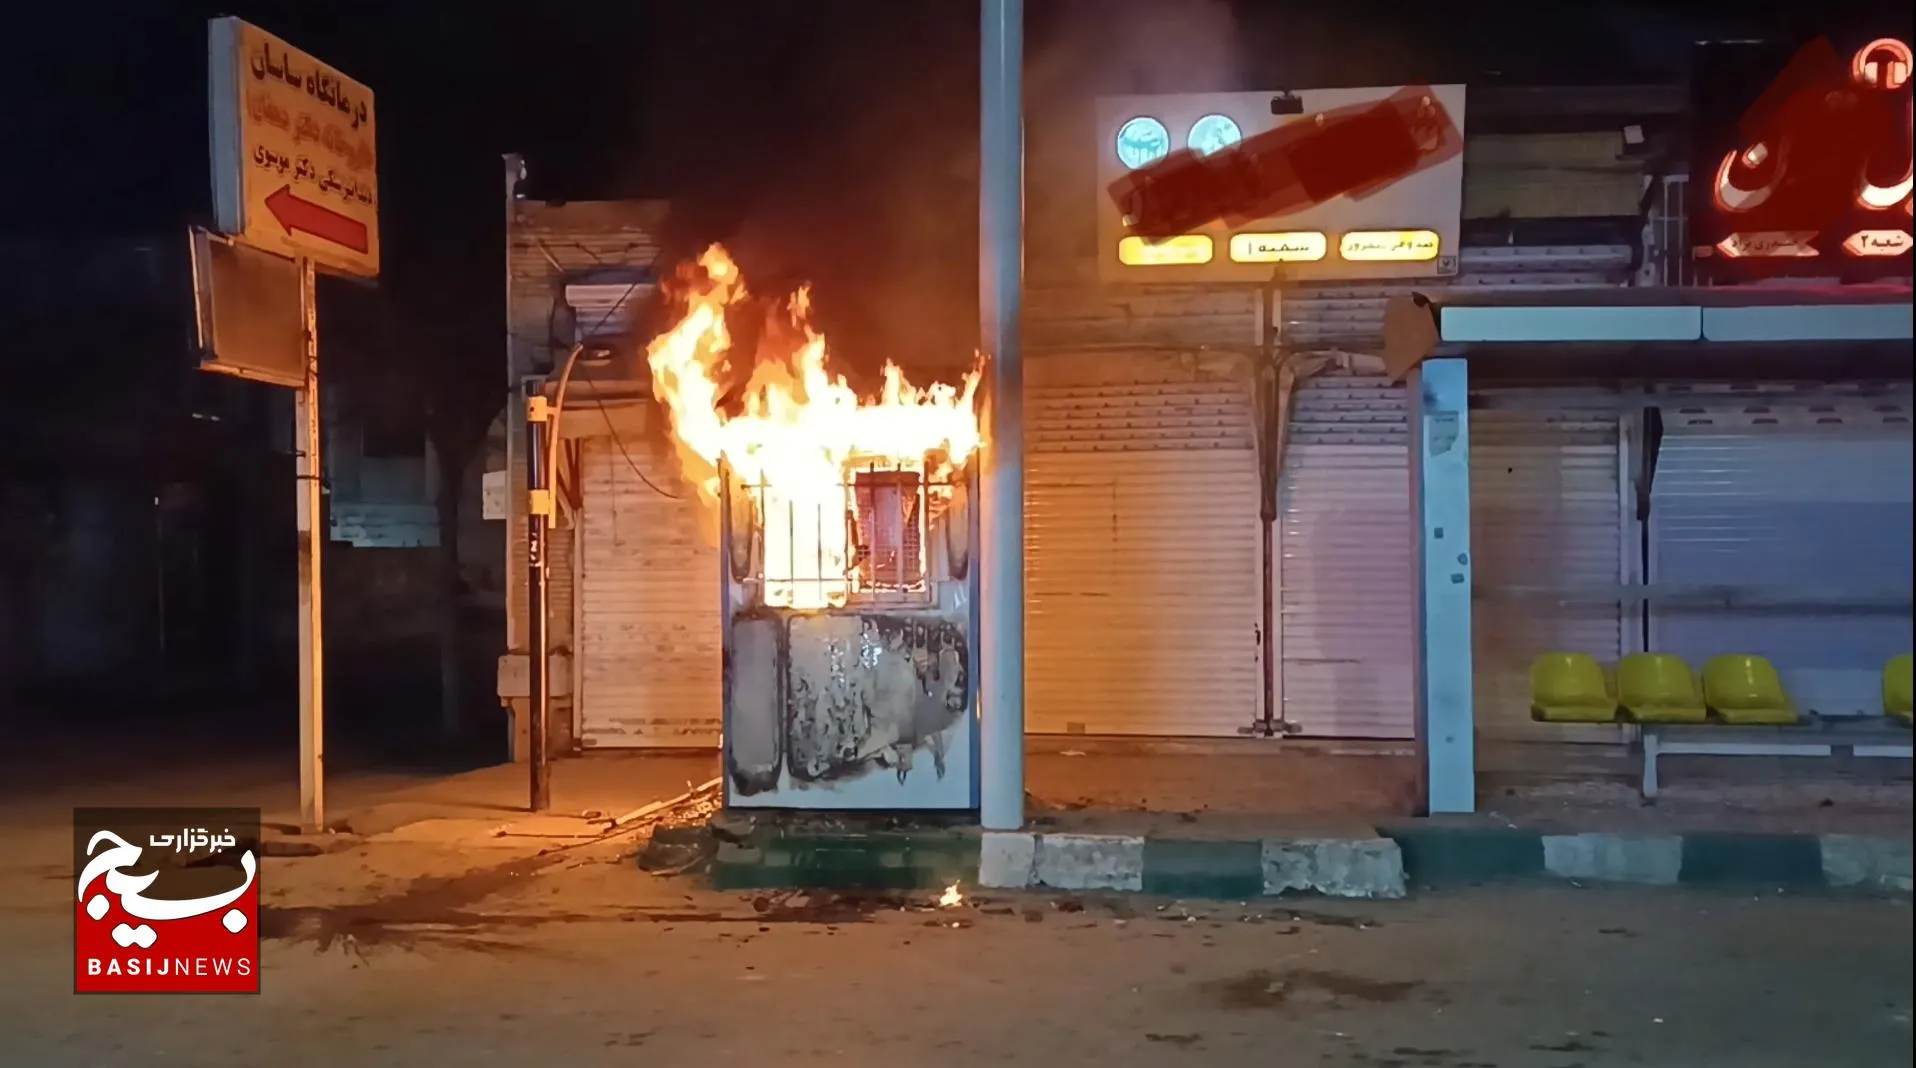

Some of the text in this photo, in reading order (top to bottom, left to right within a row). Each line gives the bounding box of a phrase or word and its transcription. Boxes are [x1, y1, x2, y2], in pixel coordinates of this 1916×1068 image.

[250, 41, 367, 129] درمانگاه ساسان
[253, 144, 290, 174] موسوی
[1860, 234, 1904, 251] شعبه ۲
